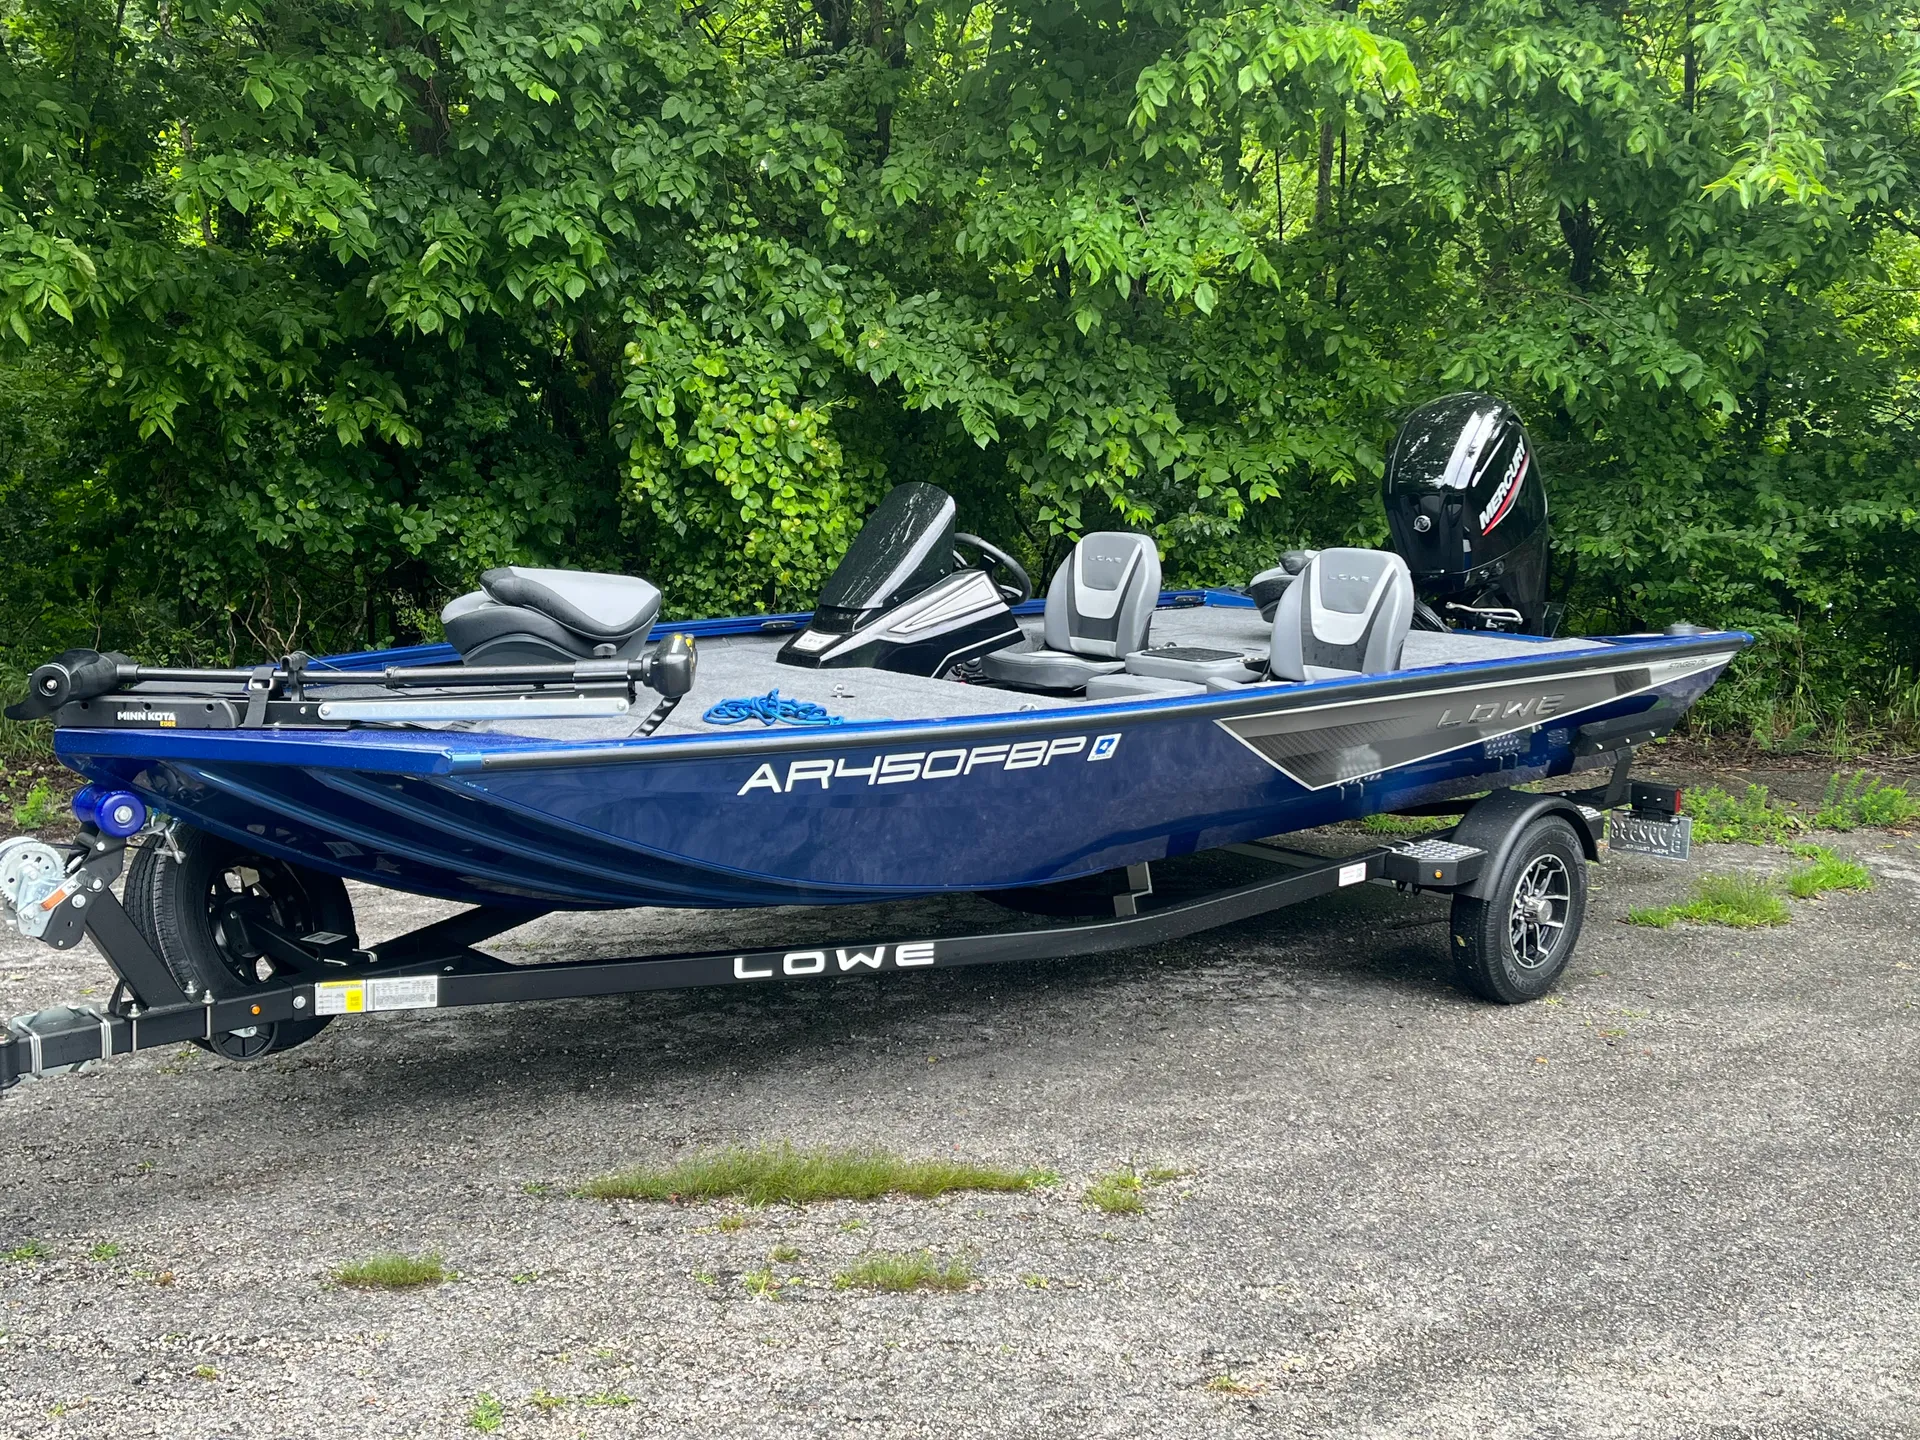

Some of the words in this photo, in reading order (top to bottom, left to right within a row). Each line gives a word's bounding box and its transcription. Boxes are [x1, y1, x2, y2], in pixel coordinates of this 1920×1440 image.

[1479, 435, 1525, 530] MERCURY
[1327, 572, 1370, 583] LOWE
[117, 711, 146, 721] MINN
[147, 712, 176, 721] KOTA
[1437, 694, 1566, 728] LOWE
[736, 736, 1088, 796] AR450FBP
[733, 942, 935, 979] LOWE
